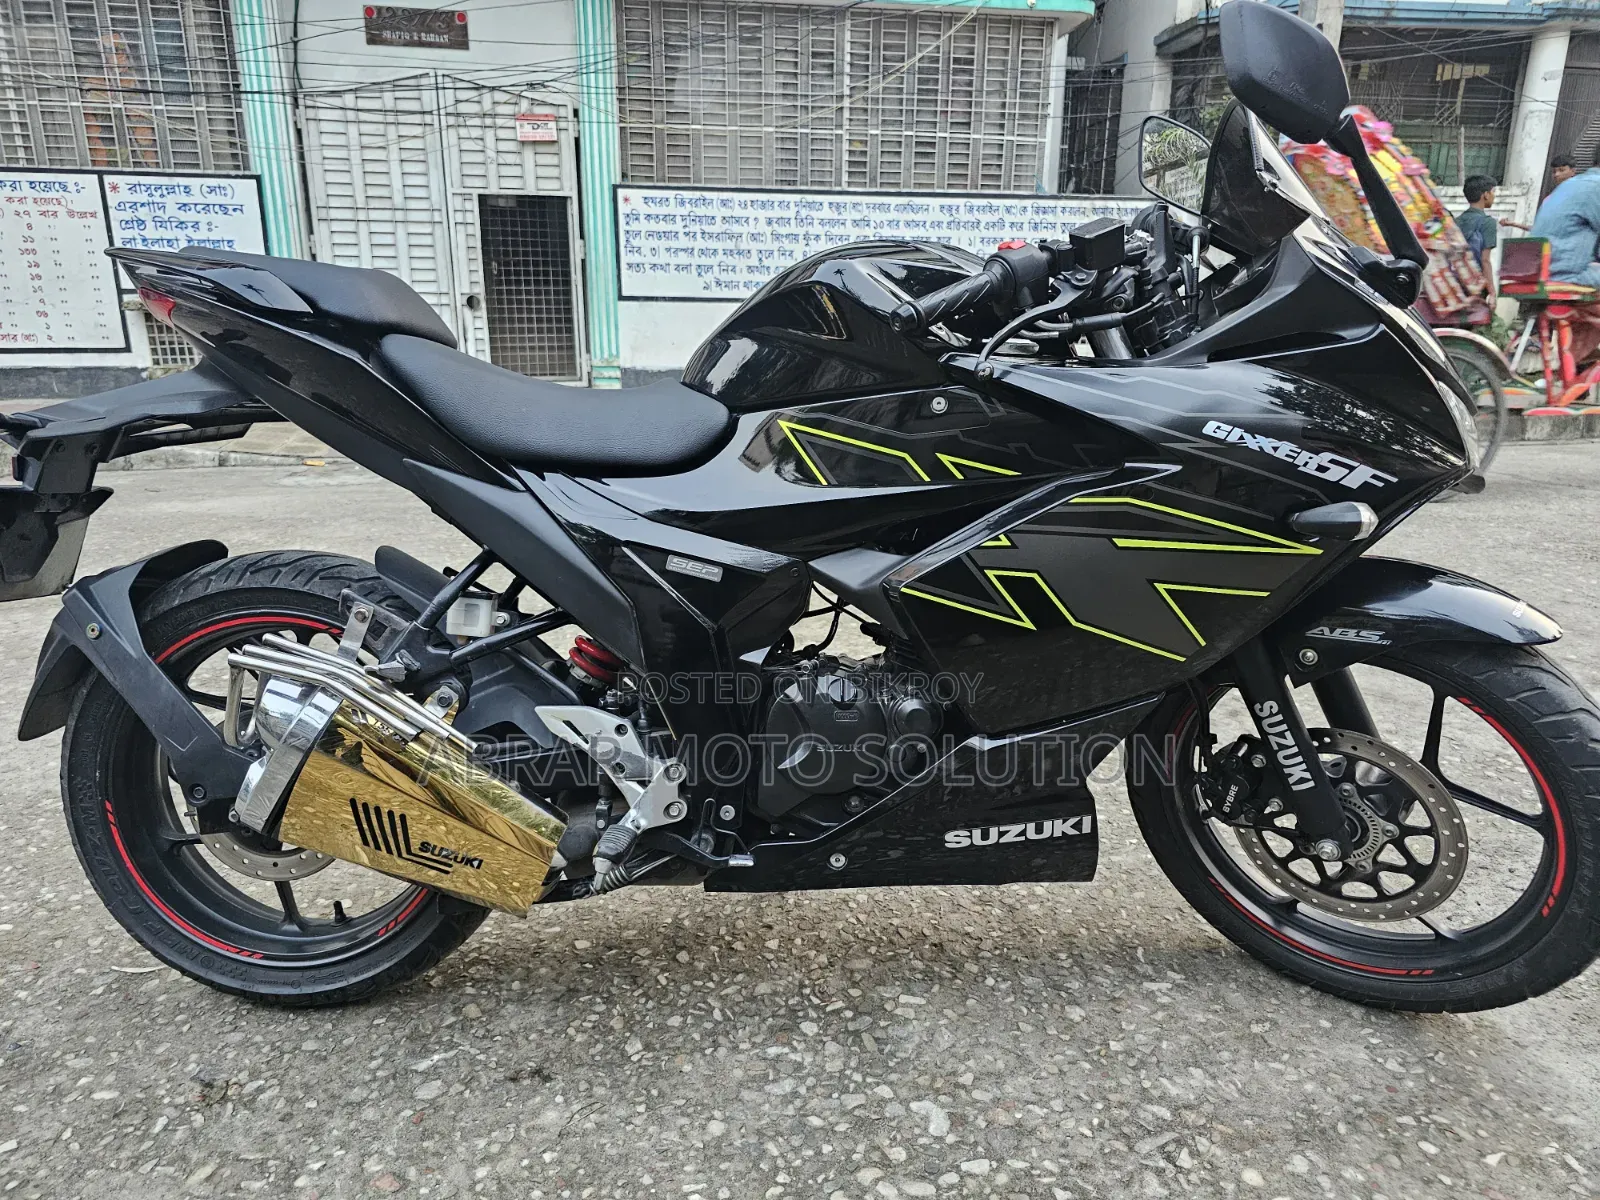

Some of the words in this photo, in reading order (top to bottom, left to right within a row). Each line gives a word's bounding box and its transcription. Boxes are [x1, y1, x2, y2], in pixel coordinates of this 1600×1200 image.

[26, 180, 72, 194] হয়েছে
[115, 199, 167, 215] এরশাদ
[175, 202, 245, 216] করেছেন
[777, 200, 791, 211] বার
[37, 209, 59, 219] বার
[120, 215, 147, 231] শ্রেষ্ঠ
[152, 216, 200, 233] যিকির
[683, 230, 698, 242] পর
[649, 262, 670, 274] কথা
[1202, 420, 1324, 471] GIXXER
[1298, 452, 1399, 490] SF
[670, 558, 719, 574] SEP
[1305, 627, 1386, 643] ABS
[1254, 701, 1316, 791] SUZUKI
[944, 815, 1092, 848] SUZUKI
[418, 841, 483, 870] SUZUKI
